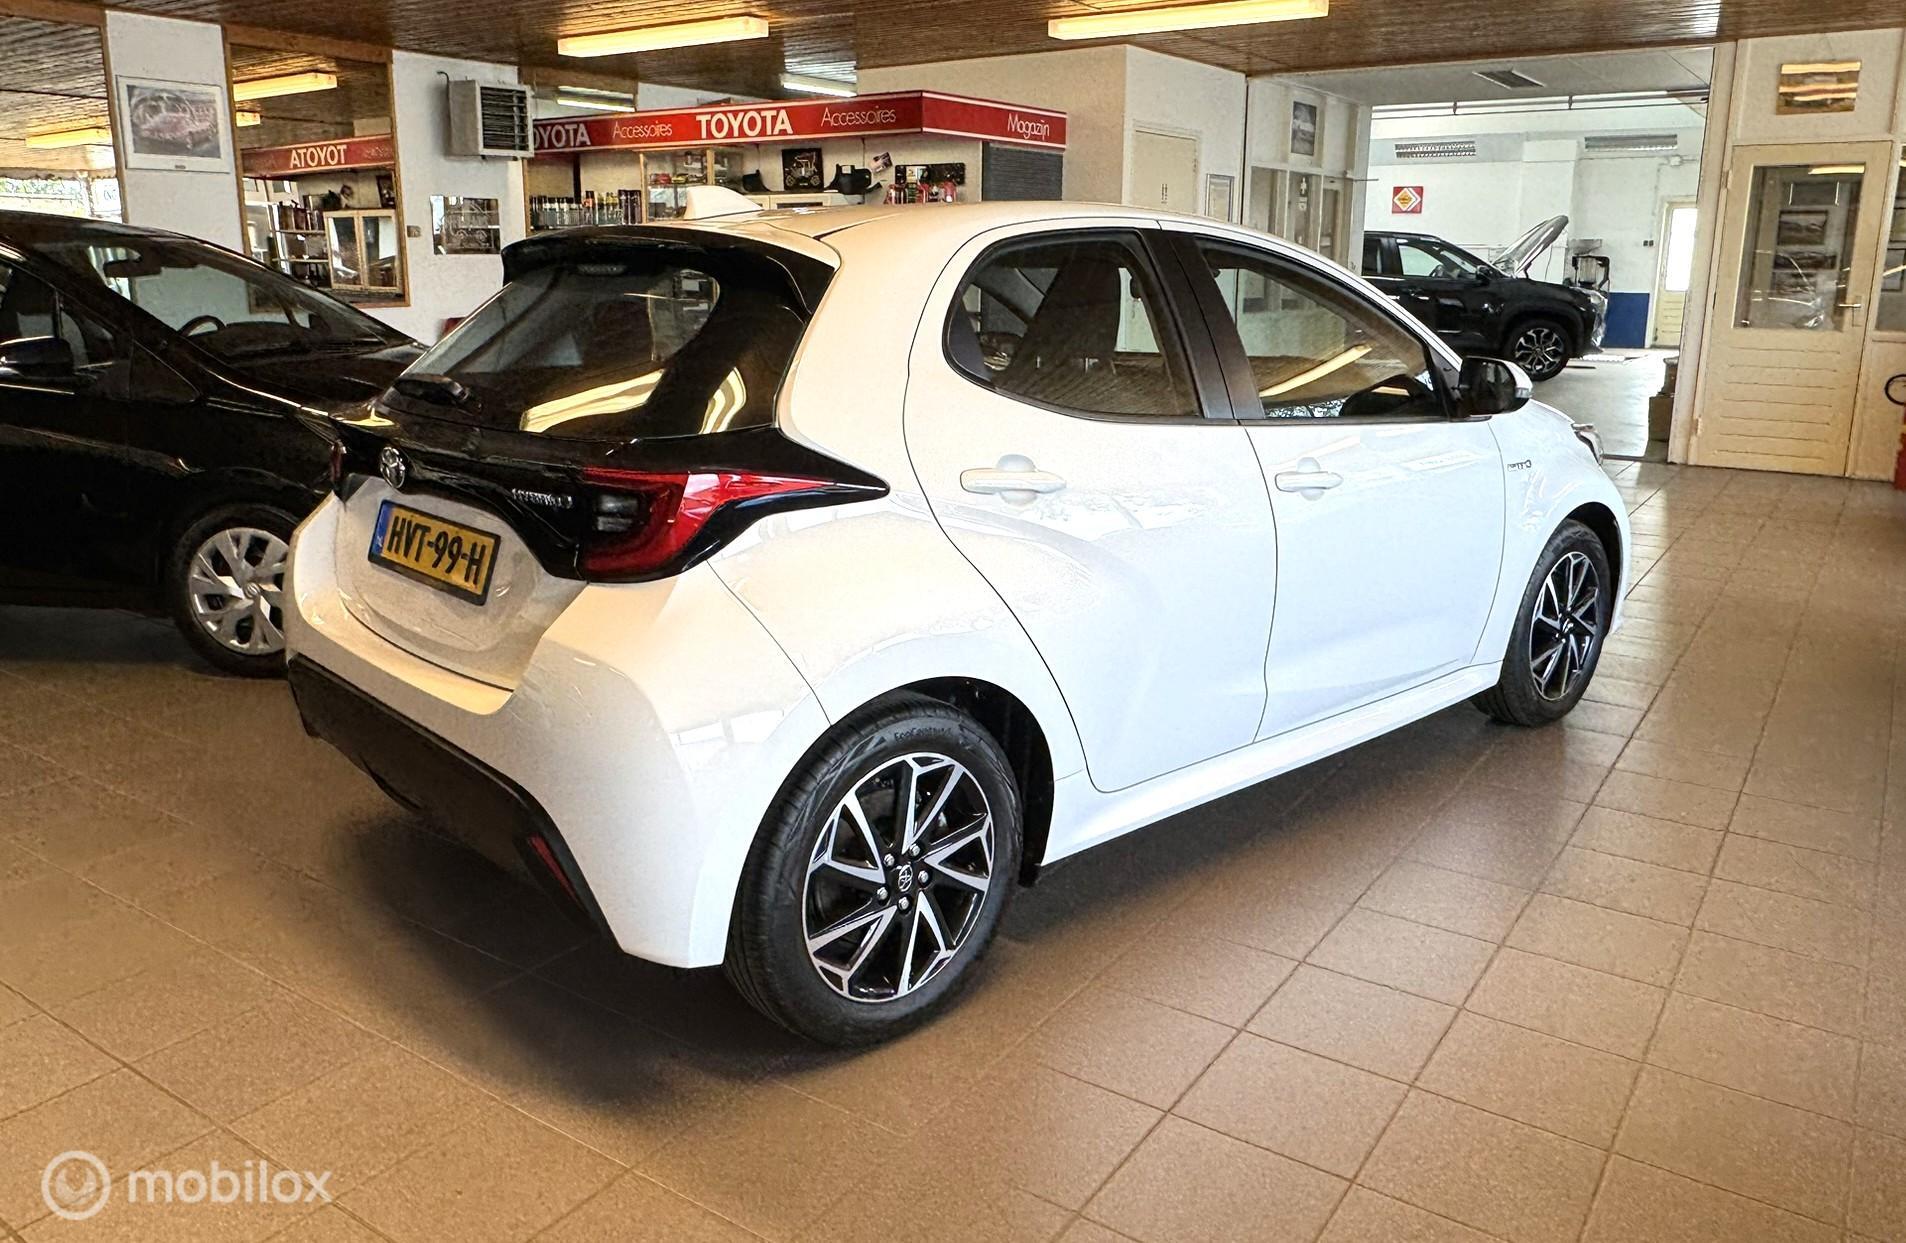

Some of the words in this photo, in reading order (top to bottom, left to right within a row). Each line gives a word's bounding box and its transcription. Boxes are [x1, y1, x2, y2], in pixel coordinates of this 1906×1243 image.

[612, 120, 673, 139] Accessoires
[695, 109, 793, 139] TOYOTA
[820, 105, 897, 128] Accessoires
[1007, 113, 1050, 141] Magazijn
[386, 515, 487, 585] HVT-99-H
